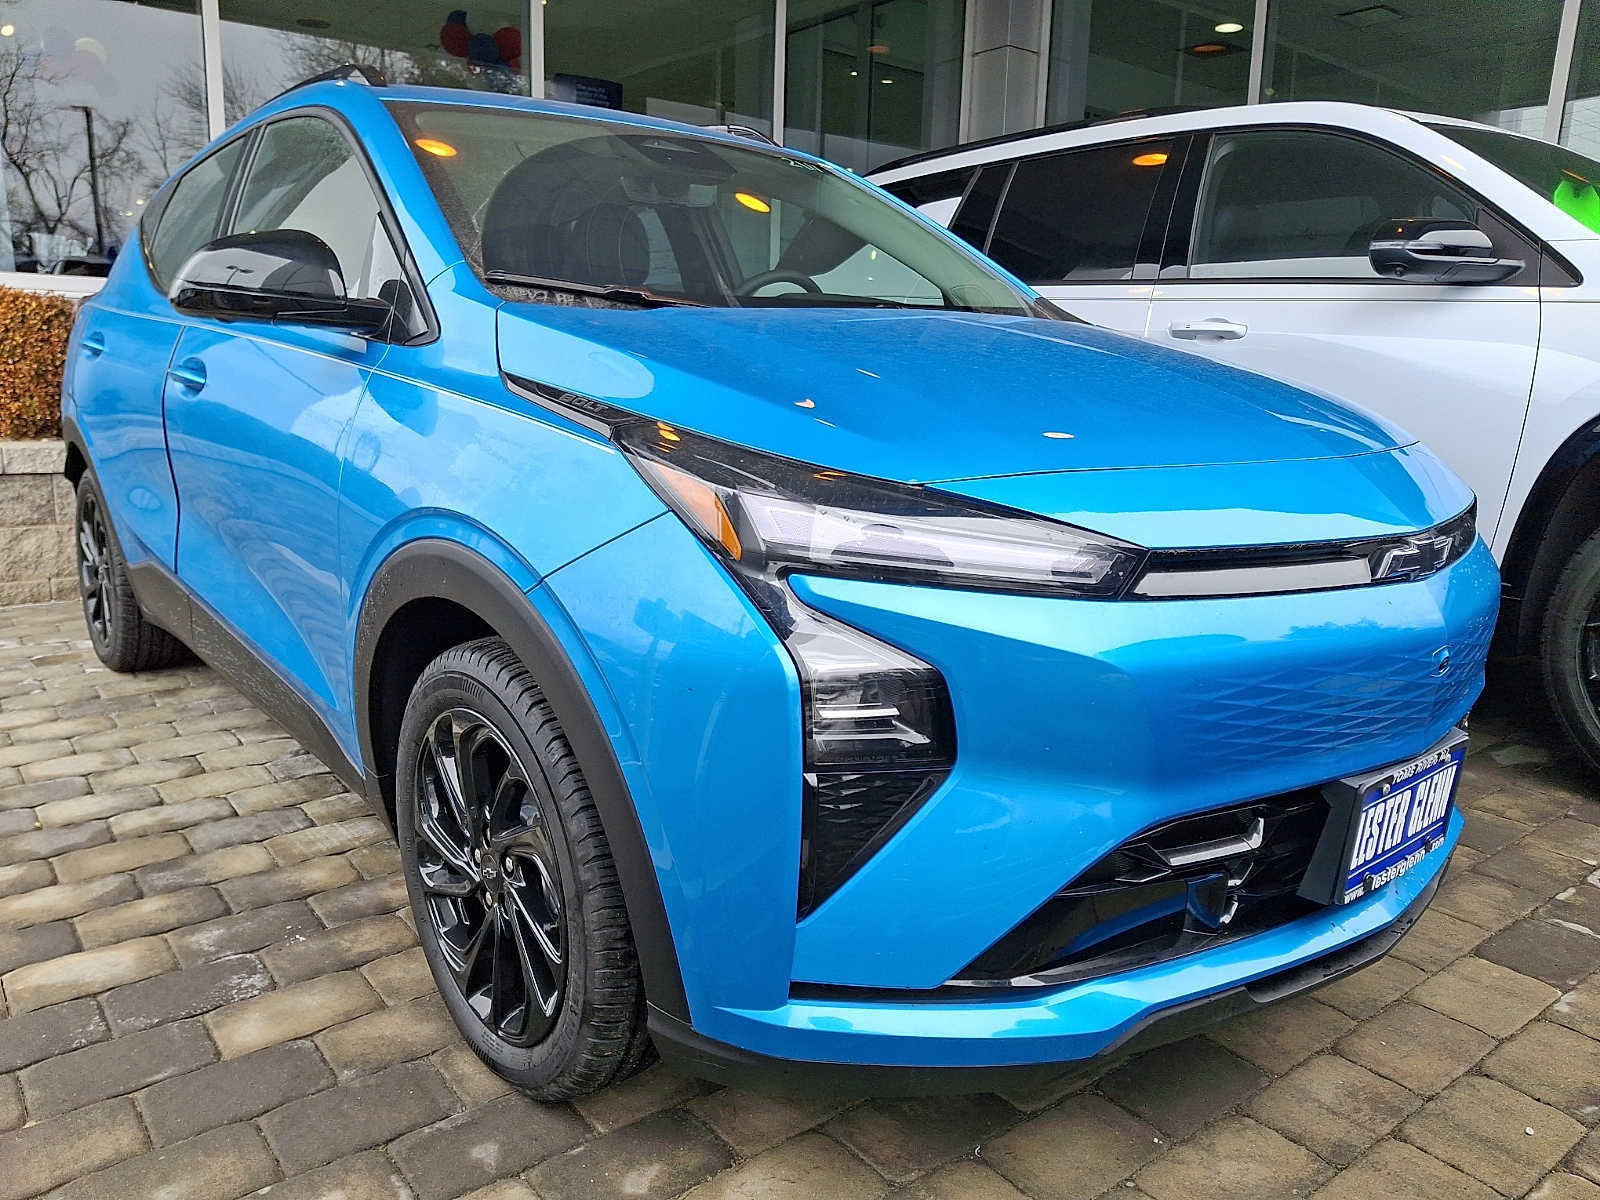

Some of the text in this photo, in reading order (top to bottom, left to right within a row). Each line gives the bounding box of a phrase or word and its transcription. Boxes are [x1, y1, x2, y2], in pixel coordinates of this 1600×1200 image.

[560, 393, 608, 412] BOLT
[1350, 765, 1457, 870] LESTER GLENN
